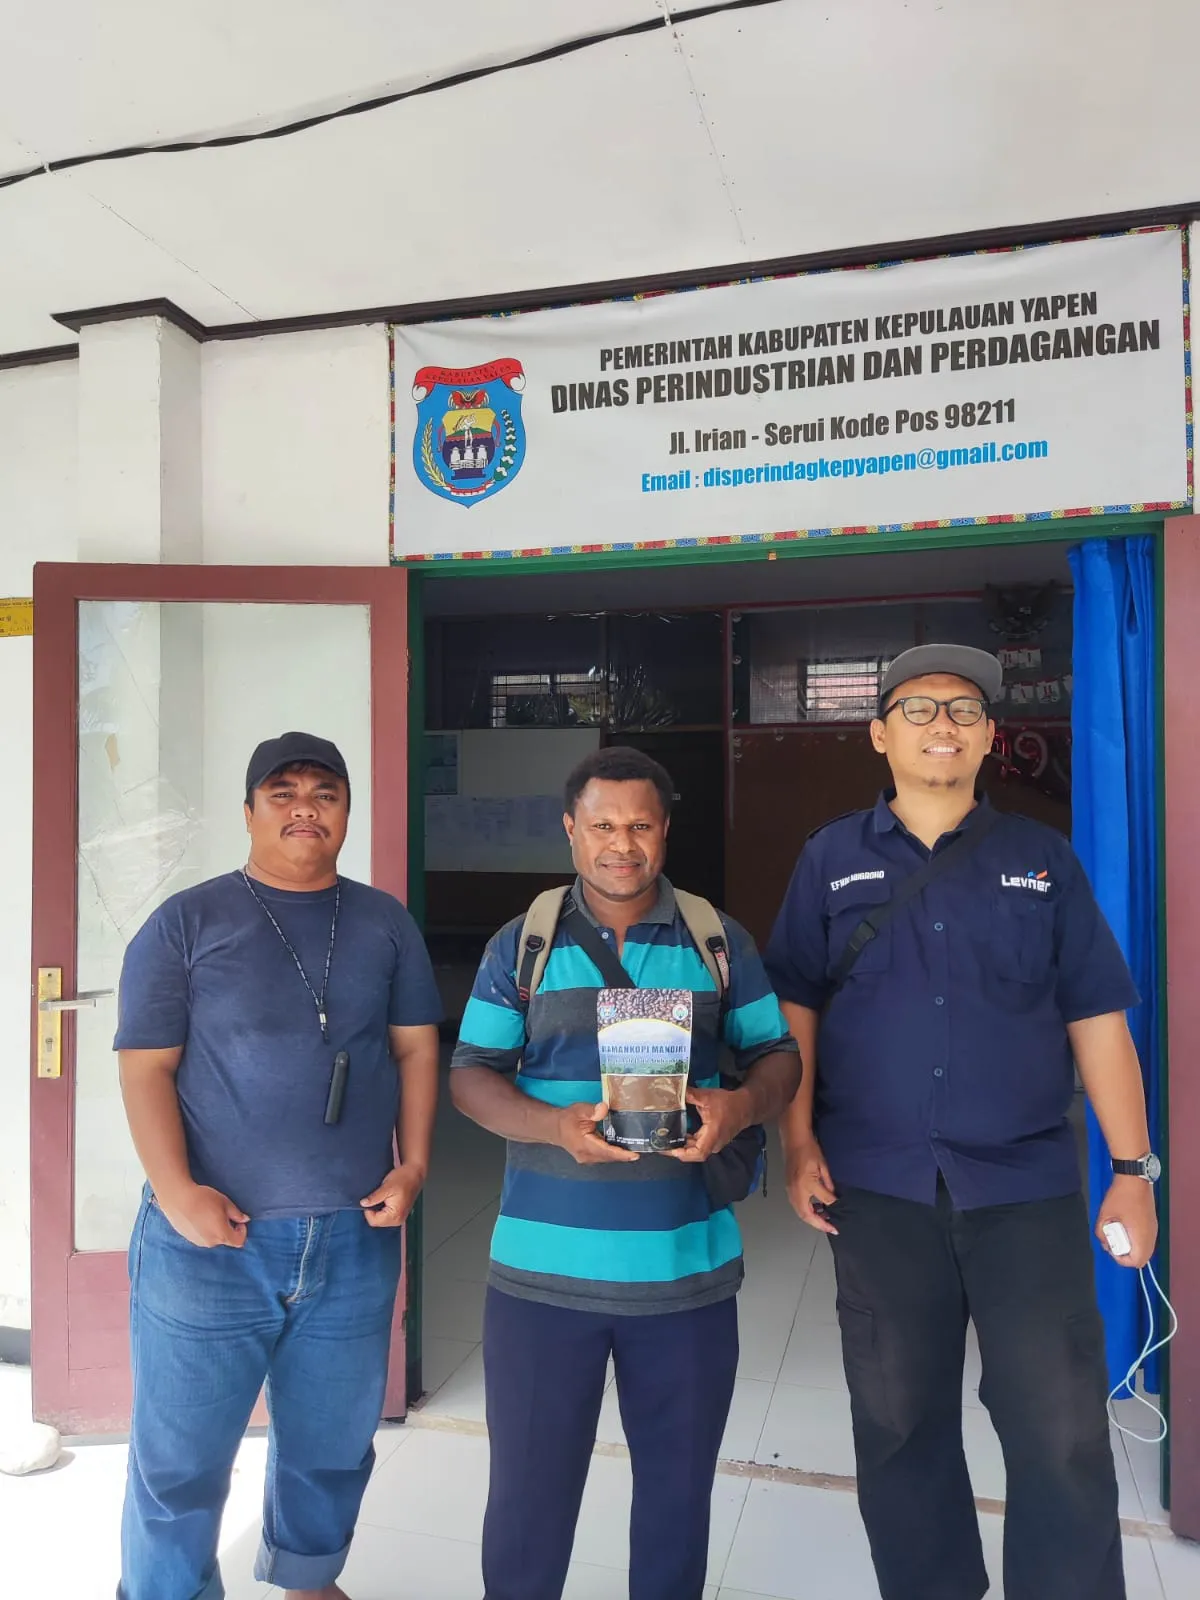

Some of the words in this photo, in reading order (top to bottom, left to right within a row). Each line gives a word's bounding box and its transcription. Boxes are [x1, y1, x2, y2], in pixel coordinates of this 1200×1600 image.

[600, 335, 732, 371] PEMERINTAH
[739, 318, 868, 356] KABUPATEN
[875, 301, 1014, 340] KEPULAUAN
[1020, 291, 1098, 324] YAPEN
[551, 379, 629, 413] DINAS
[636, 354, 854, 404] PERINDUSTRIAN
[864, 345, 922, 381] DAN
[931, 319, 1160, 374] PERDAGANGAN
[669, 432, 690, 455] Jl.
[695, 428, 746, 452] Irian
[765, 418, 824, 446] Serui
[831, 413, 889, 440] Kode
[896, 410, 938, 433] Pos
[945, 398, 1014, 429] 98211
[641, 469, 691, 493] Email
[703, 440, 1049, 488] disperindagkepyapen@gmail.com
